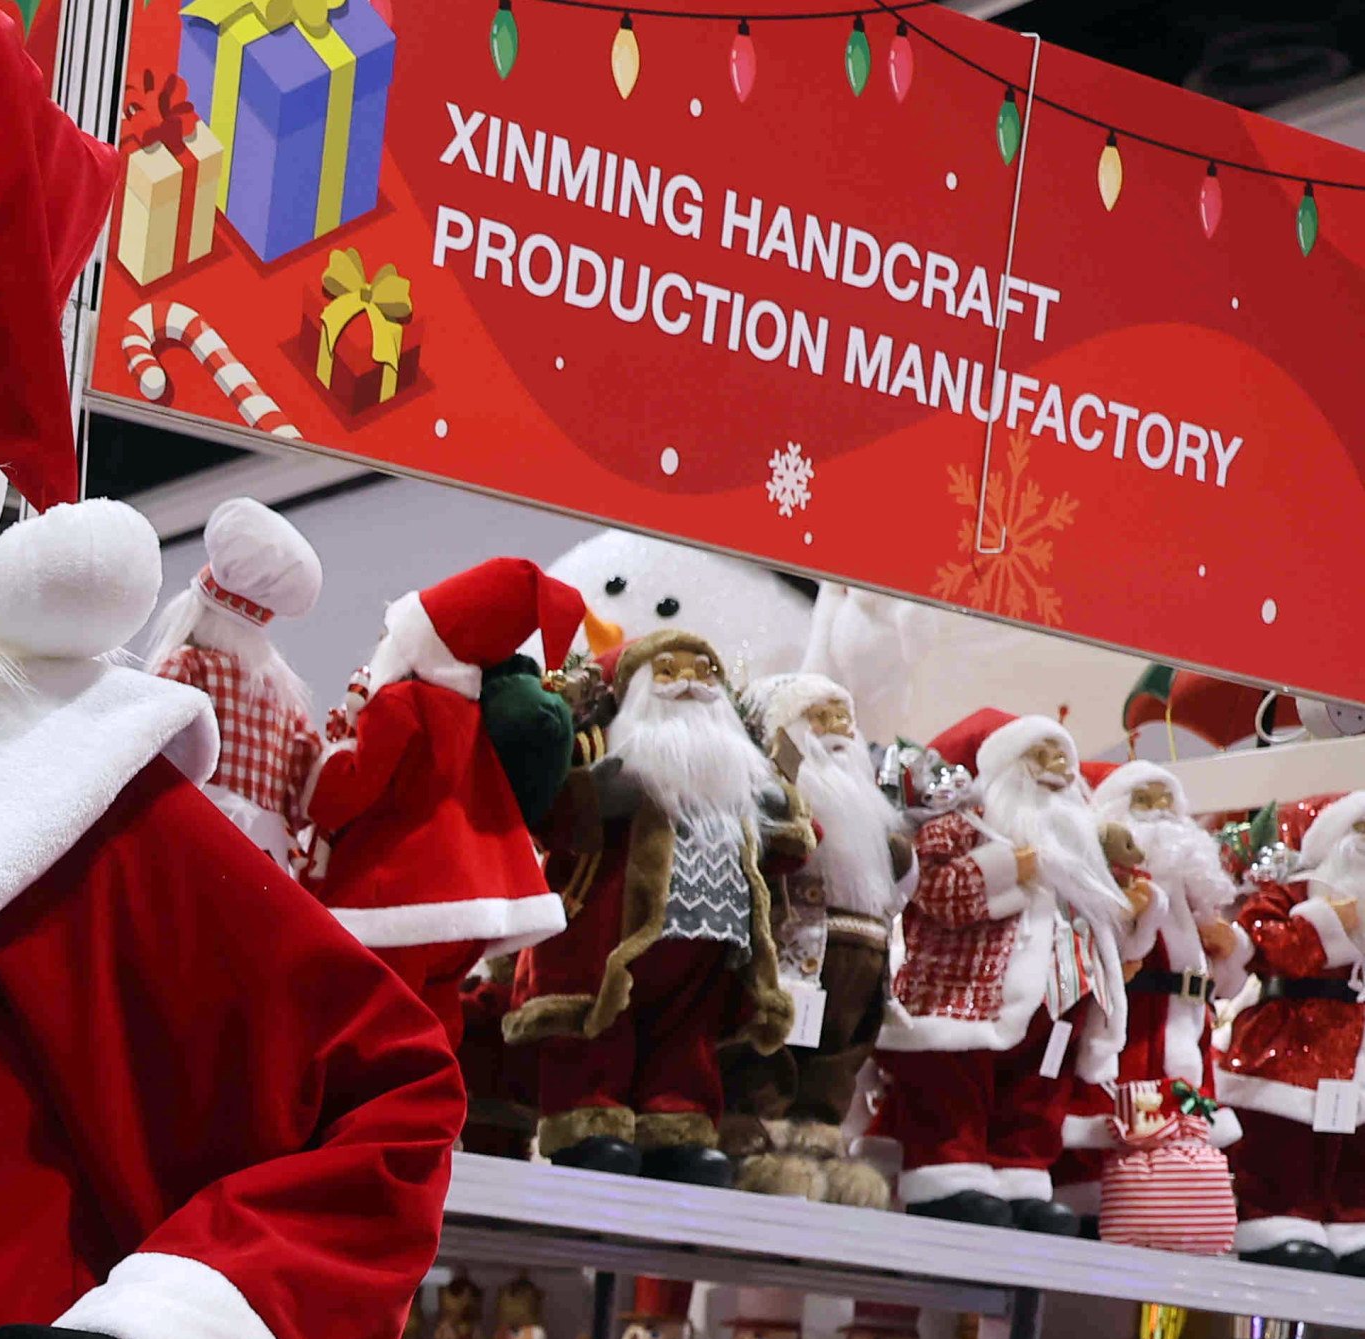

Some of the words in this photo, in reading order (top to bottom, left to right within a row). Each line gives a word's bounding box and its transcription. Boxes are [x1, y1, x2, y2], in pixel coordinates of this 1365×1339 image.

[431, 205, 831, 376] PRODUCTION
[843, 326, 1244, 488] MANUFACTORY
[439, 102, 705, 240] XINMING
[720, 188, 1061, 344] HANDCRAFT
